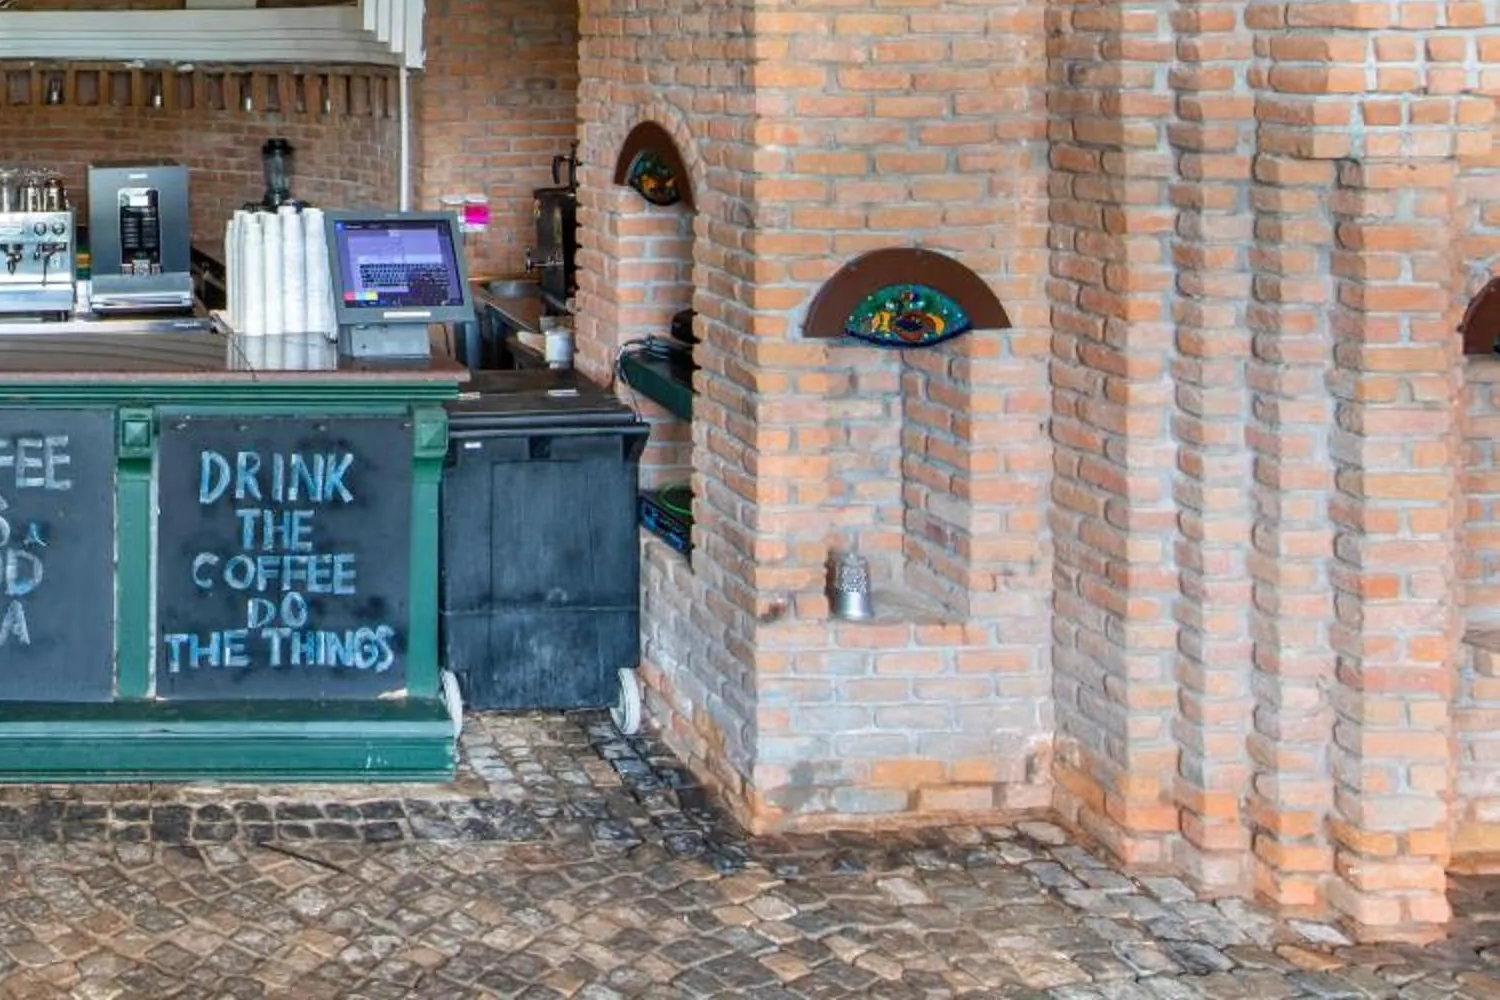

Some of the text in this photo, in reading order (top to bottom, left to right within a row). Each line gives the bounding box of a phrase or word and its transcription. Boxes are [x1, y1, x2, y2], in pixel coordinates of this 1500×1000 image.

[199, 451, 355, 504] DRINK
[235, 508, 315, 552] THE
[192, 551, 357, 596] COFFEE
[247, 591, 309, 629] DO
[164, 624, 396, 673] THE THINGS
